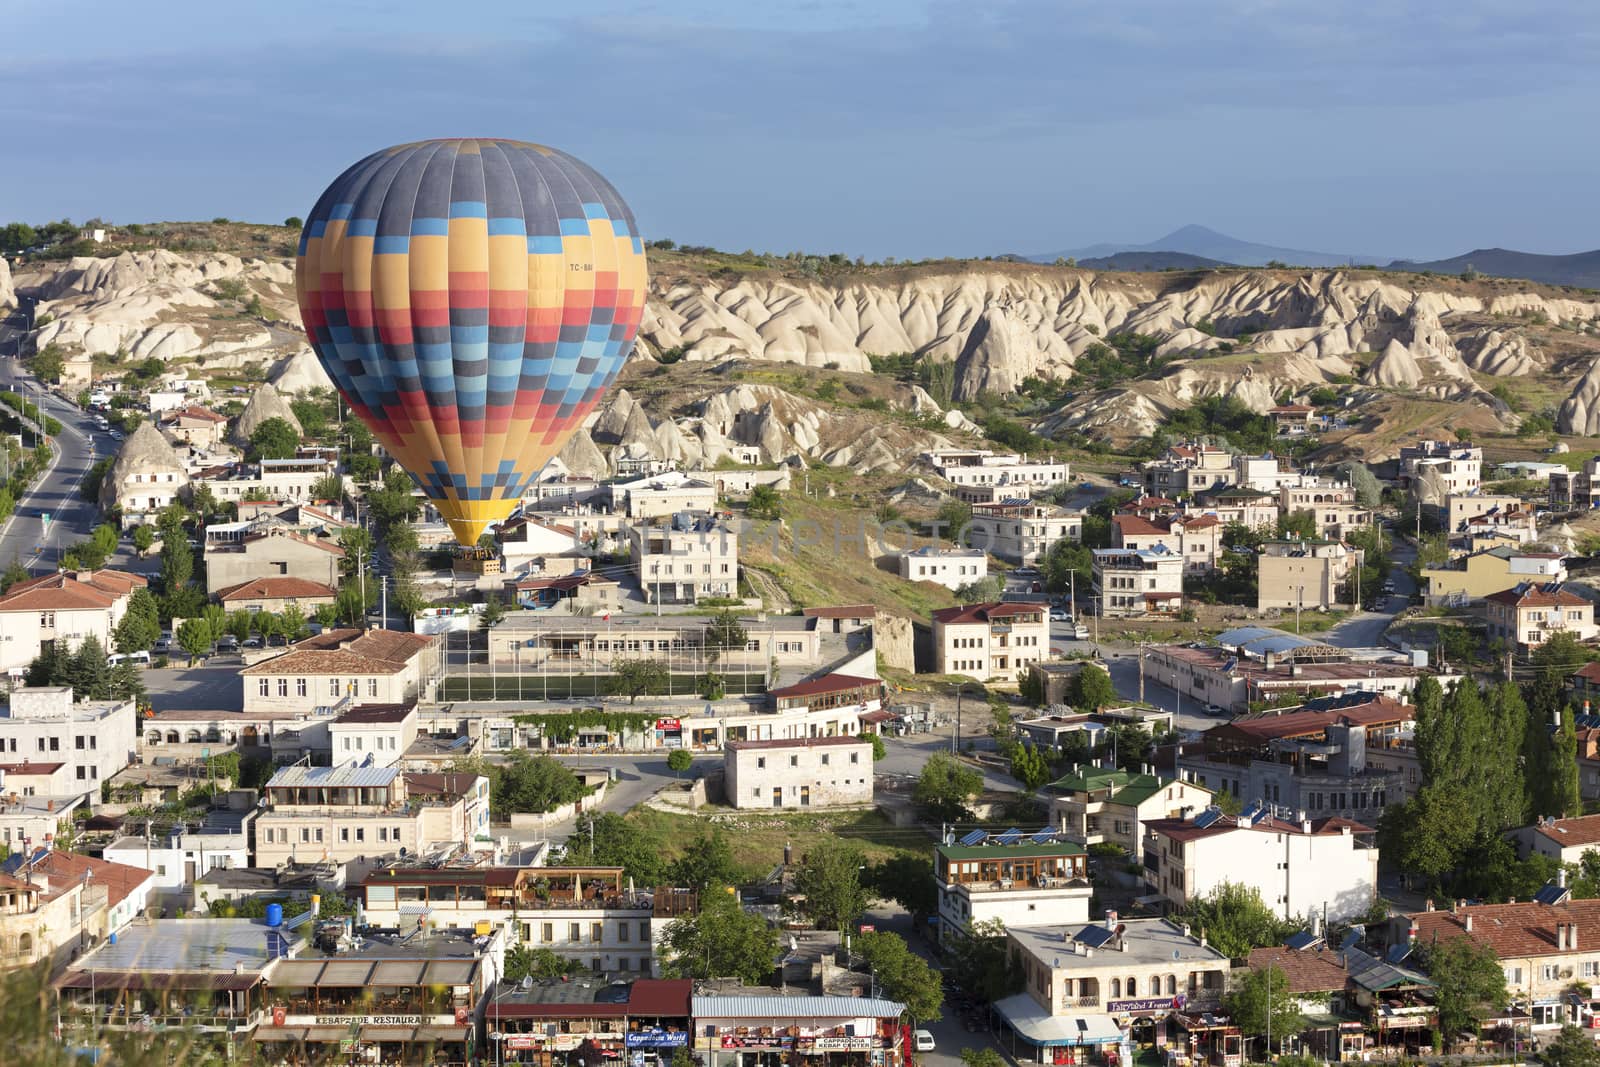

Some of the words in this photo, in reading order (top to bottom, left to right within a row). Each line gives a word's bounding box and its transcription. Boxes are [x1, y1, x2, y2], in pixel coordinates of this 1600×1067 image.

[1112, 1002, 1146, 1011] Fairyland
[1147, 1001, 1172, 1009] Travel
[666, 1033, 686, 1041] World
